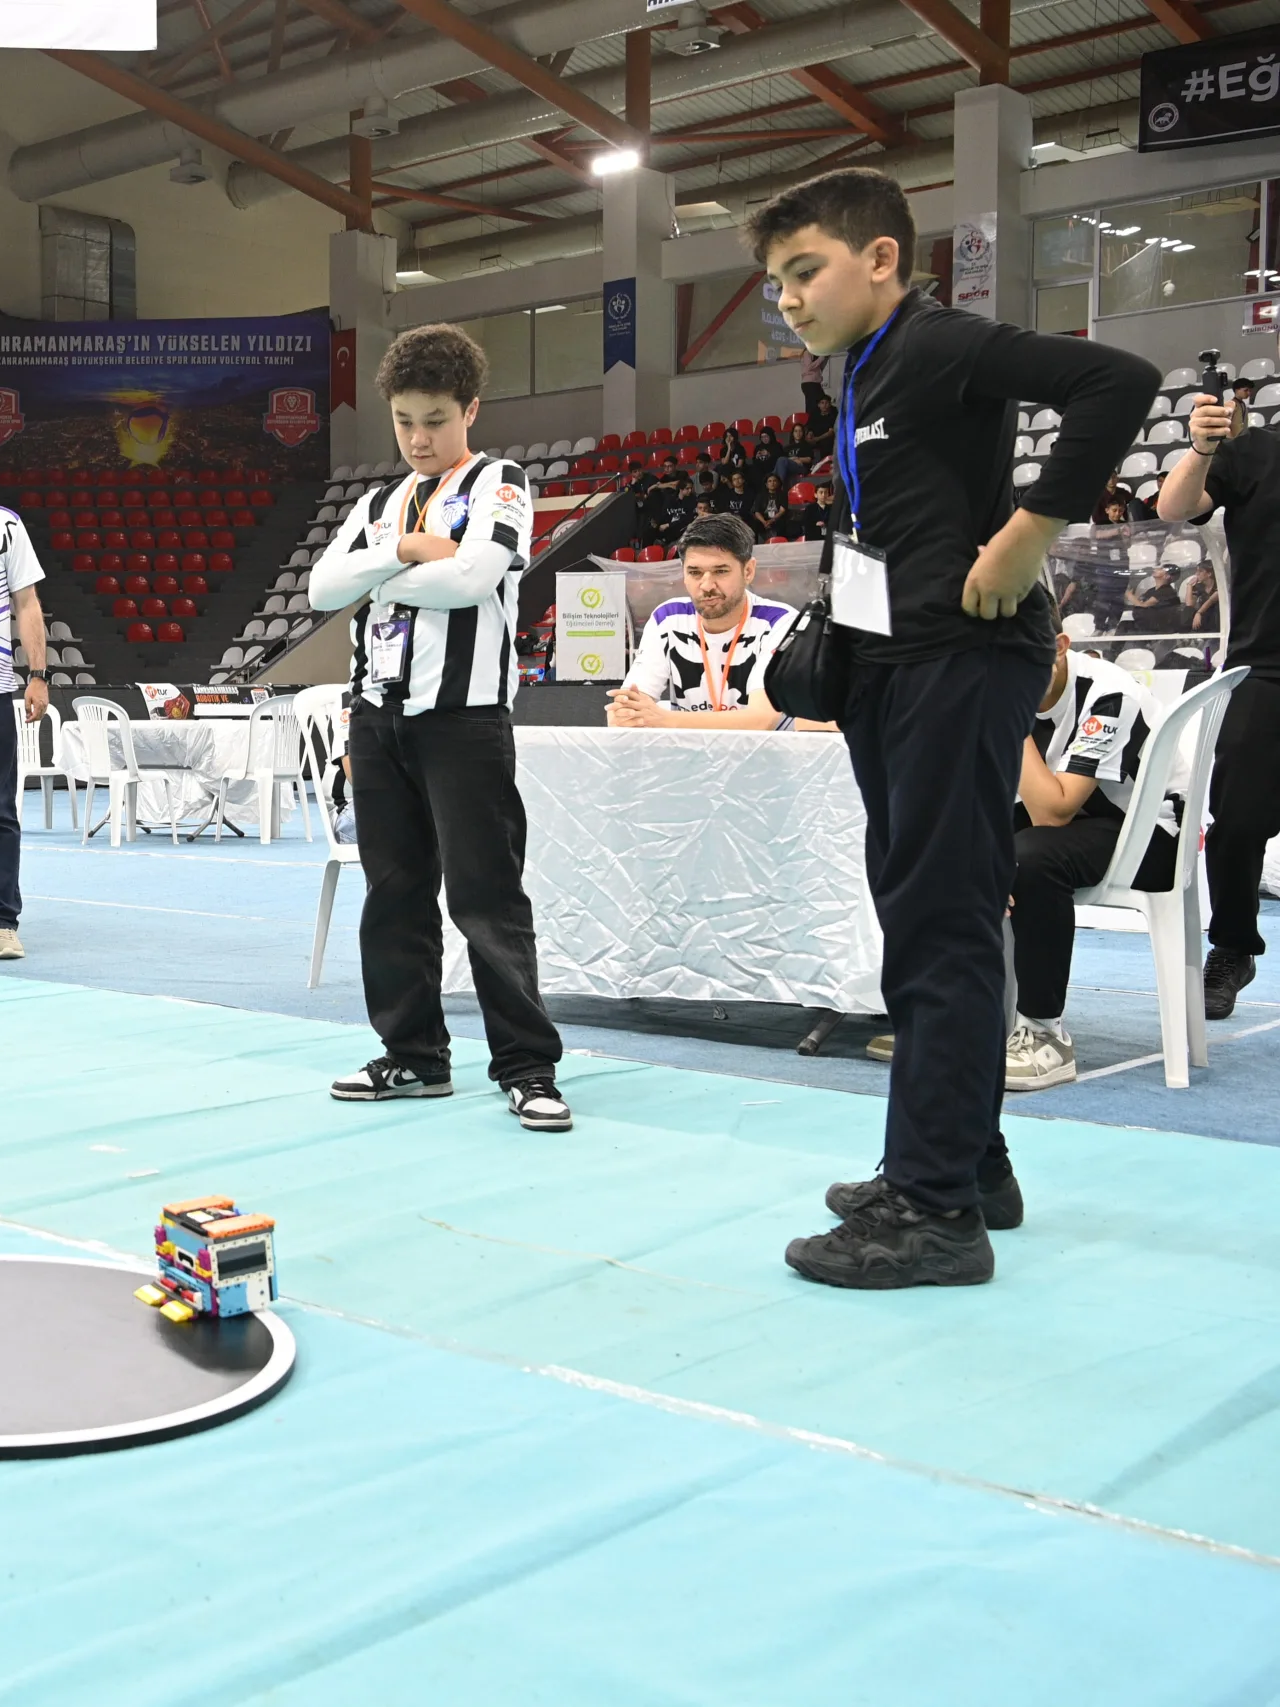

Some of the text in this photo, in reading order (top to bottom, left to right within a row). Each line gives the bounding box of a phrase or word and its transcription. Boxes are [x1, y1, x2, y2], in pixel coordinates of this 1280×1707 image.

[157, 335, 240, 352] YÜKSELEN
[247, 334, 312, 352] YILDIZI
[72, 356, 123, 366] BÜYÜKŞEHİR
[126, 355, 164, 365] BELEDİYE
[167, 356, 188, 365] SPOR
[191, 356, 217, 365] KADIN
[220, 356, 261, 366] VOLEYBOL
[264, 356, 294, 366] TAKIMI
[562, 612, 619, 622] Bilişim Teknolojileri
[156, 688, 168, 696] tur
[221, 694, 229, 702] VE
